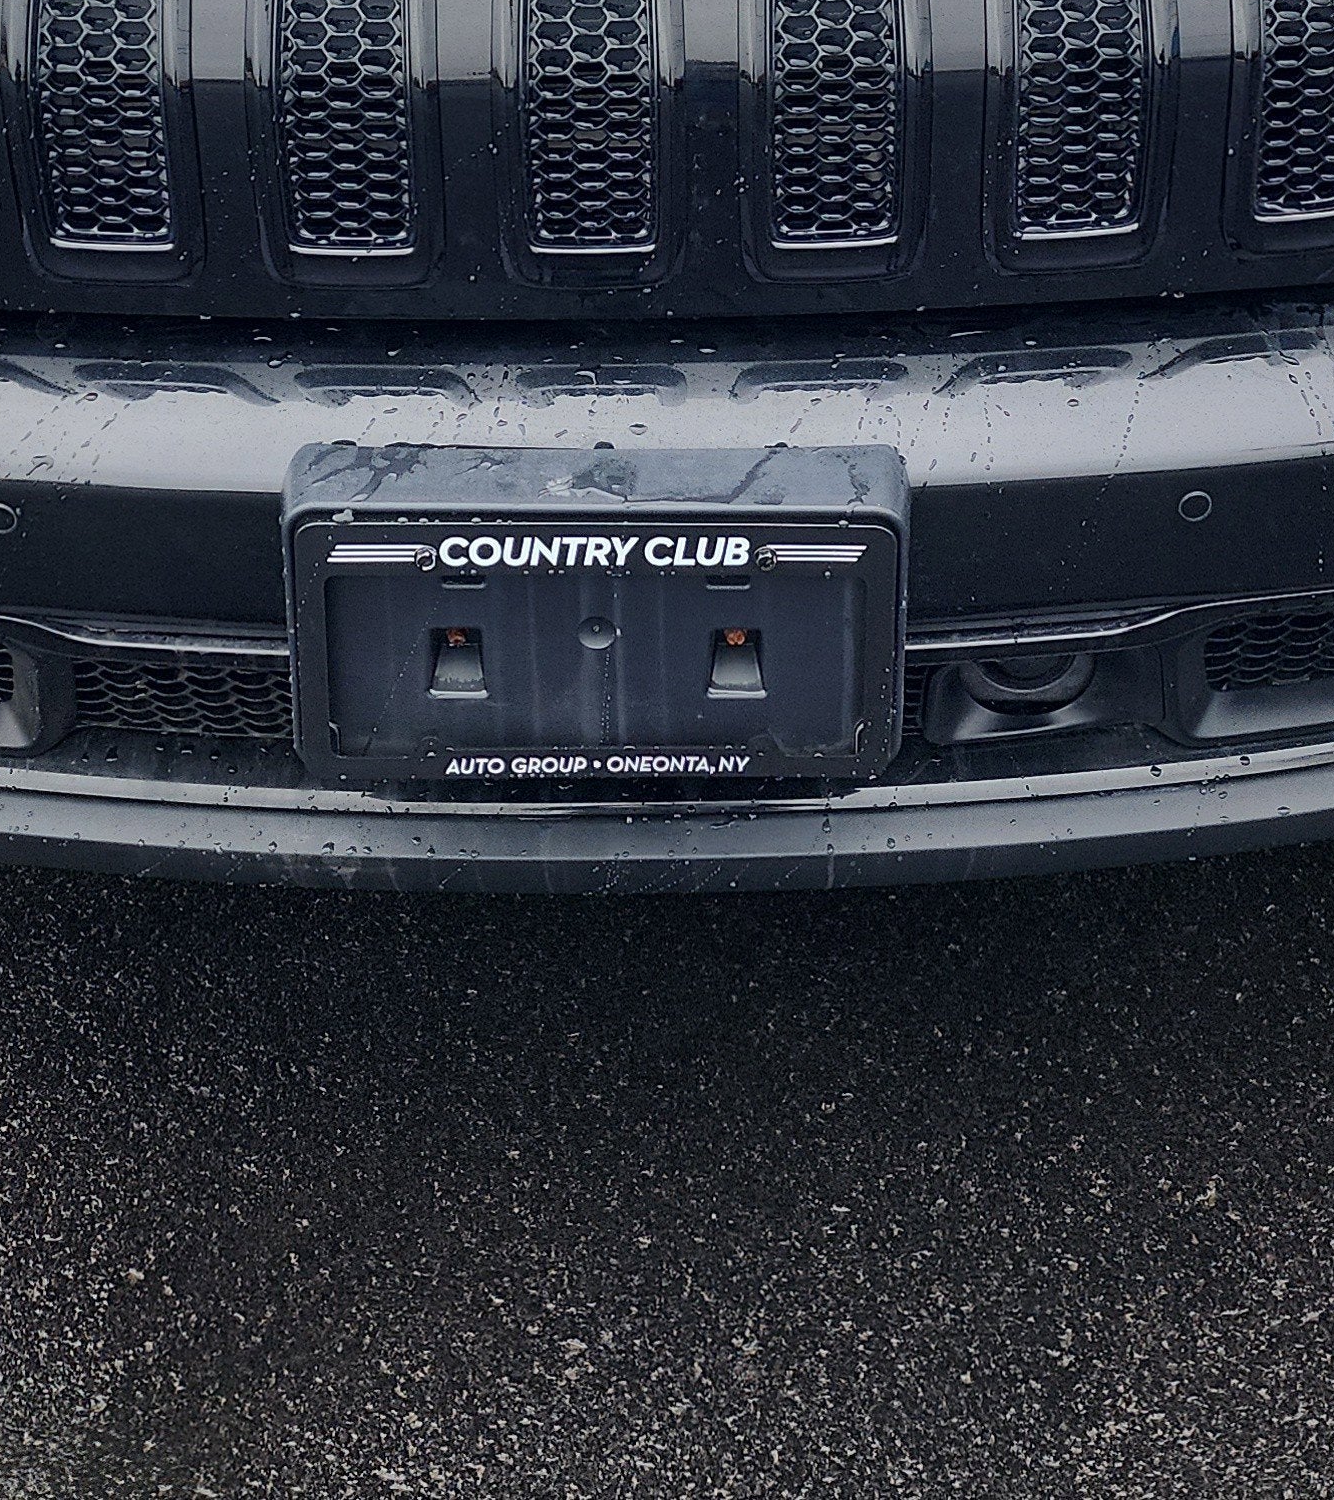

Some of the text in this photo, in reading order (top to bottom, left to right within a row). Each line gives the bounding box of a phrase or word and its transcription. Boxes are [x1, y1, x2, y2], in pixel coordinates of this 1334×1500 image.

[439, 536, 750, 567] COUNTRY CLUB
[445, 757, 505, 775] AUTO
[511, 757, 587, 774] GROUP
